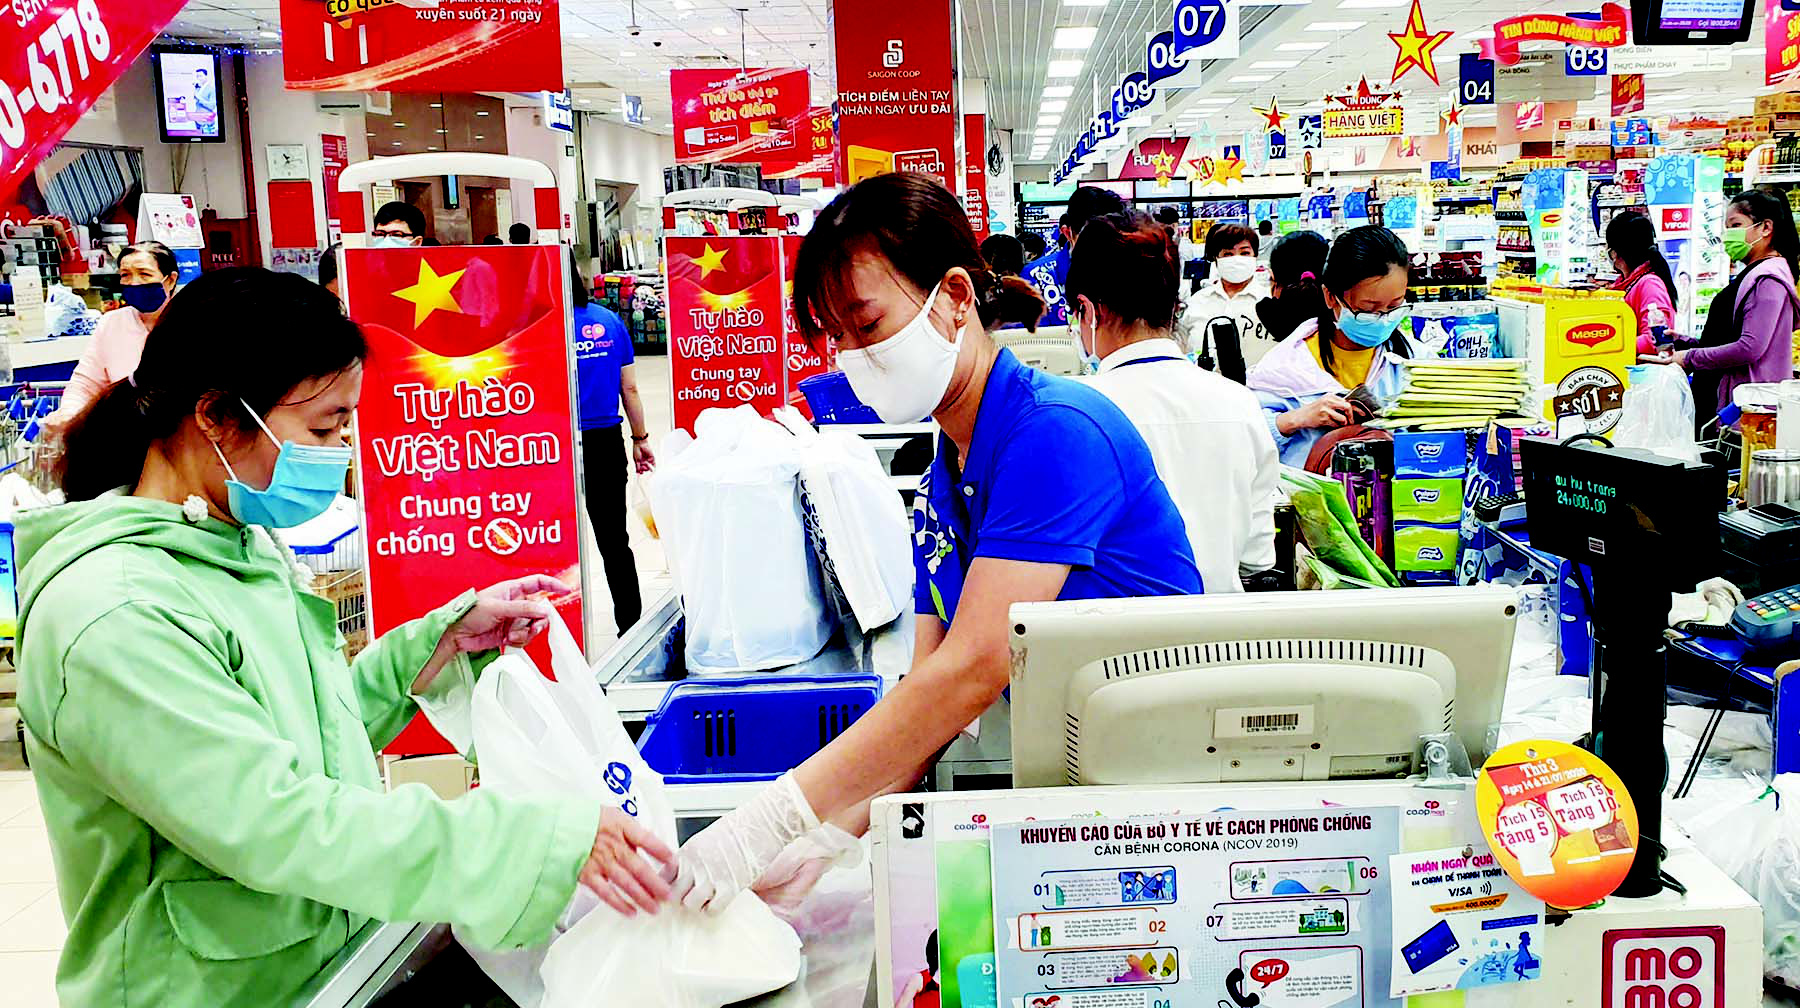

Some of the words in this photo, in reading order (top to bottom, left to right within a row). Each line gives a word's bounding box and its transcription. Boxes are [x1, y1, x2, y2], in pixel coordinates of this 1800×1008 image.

[416, 8, 455, 22] xuyên
[459, 6, 487, 20] suốt
[490, 8, 505, 21] 21
[510, 6, 541, 23] ngày
[1178, 6, 1219, 36] 07
[1501, 23, 1522, 39] TIN
[1523, 18, 1558, 34] DÙNG
[1559, 23, 1593, 42] HÀNG
[1594, 25, 1621, 43] VIỆT
[1570, 46, 1604, 71] 03
[867, 71, 897, 79] SAIGON
[897, 70, 921, 78] COOP
[838, 90, 867, 102] TÍCH
[869, 88, 899, 102] ĐIỂM
[902, 88, 928, 101] LIỀN
[930, 90, 950, 101] TAY
[1124, 80, 1153, 102] 09
[1463, 80, 1492, 101] 04
[1346, 97, 1358, 106] TIN
[1359, 94, 1383, 106] DÙNG
[709, 106, 737, 123] tích
[839, 105, 873, 118] NHẬN
[875, 104, 906, 115] NGAY
[909, 104, 928, 115] ƯU
[930, 102, 951, 115] ĐÃI
[1329, 113, 1365, 128] HÀNG
[1368, 111, 1397, 130] VIỆT
[1270, 144, 1284, 157] 07
[1466, 139, 1498, 156] KHÁT
[900, 159, 945, 174] khách
[1664, 221, 1690, 230] VIFON
[689, 308, 721, 333] Tự
[721, 306, 764, 328] hào
[1457, 335, 1482, 350] 애니
[1571, 328, 1610, 340] Maggi
[677, 334, 723, 362] Việt
[726, 333, 777, 355] Nam
[790, 342, 808, 354] tay
[1468, 346, 1488, 358] 타임
[690, 368, 735, 382] Chung
[738, 367, 761, 381] tay
[677, 383, 721, 401] chống
[393, 383, 453, 430] Tự
[456, 376, 535, 418] hào
[372, 432, 461, 482] Việt
[465, 428, 560, 470] Nam
[400, 495, 482, 520] Chung
[488, 491, 532, 516] tay
[1556, 489, 1607, 514] 24,000.00
[376, 525, 455, 556] chống
[1519, 758, 1546, 779] Thứ
[1546, 758, 1558, 772] 3
[1560, 790, 1587, 805] Tích
[1588, 784, 1604, 797] 15
[1500, 812, 1528, 827] Tích
[1530, 807, 1546, 820] 15
[1555, 804, 1595, 824] Tặng
[1599, 796, 1618, 813] 10
[1020, 824, 1077, 844] KHUYẾN
[1081, 822, 1109, 842] CÁO
[1114, 820, 1143, 840] CỦA
[1147, 823, 1166, 841] BỘ
[1170, 823, 1180, 839] Y
[1184, 818, 1202, 837] TẾ
[1206, 817, 1224, 836] VỀ
[1227, 819, 1266, 836] CÁCH
[1269, 816, 1319, 834] PHÒNG
[1322, 811, 1372, 832] CHỐNG
[1494, 829, 1536, 848] Tặng
[1537, 821, 1550, 837] 5
[1094, 843, 1123, 857] CĂN
[1125, 841, 1162, 860] BỆNH
[1164, 842, 1220, 853] CORONA
[1223, 840, 1263, 853] (NCOV
[1266, 838, 1298, 851] 2019)
[1411, 860, 1439, 875] NHẬN
[1441, 857, 1468, 872] NGAY
[1471, 853, 1494, 868] QUÀ
[1360, 867, 1378, 879] 06
[1456, 870, 1481, 881] THANH
[1482, 867, 1502, 879] TOÁN
[1033, 884, 1050, 897] 01
[1448, 886, 1473, 897] VISA
[1149, 921, 1166, 933] 02
[1206, 916, 1224, 928] 07
[1037, 964, 1055, 977] 03
[1257, 964, 1284, 977] 24/7
